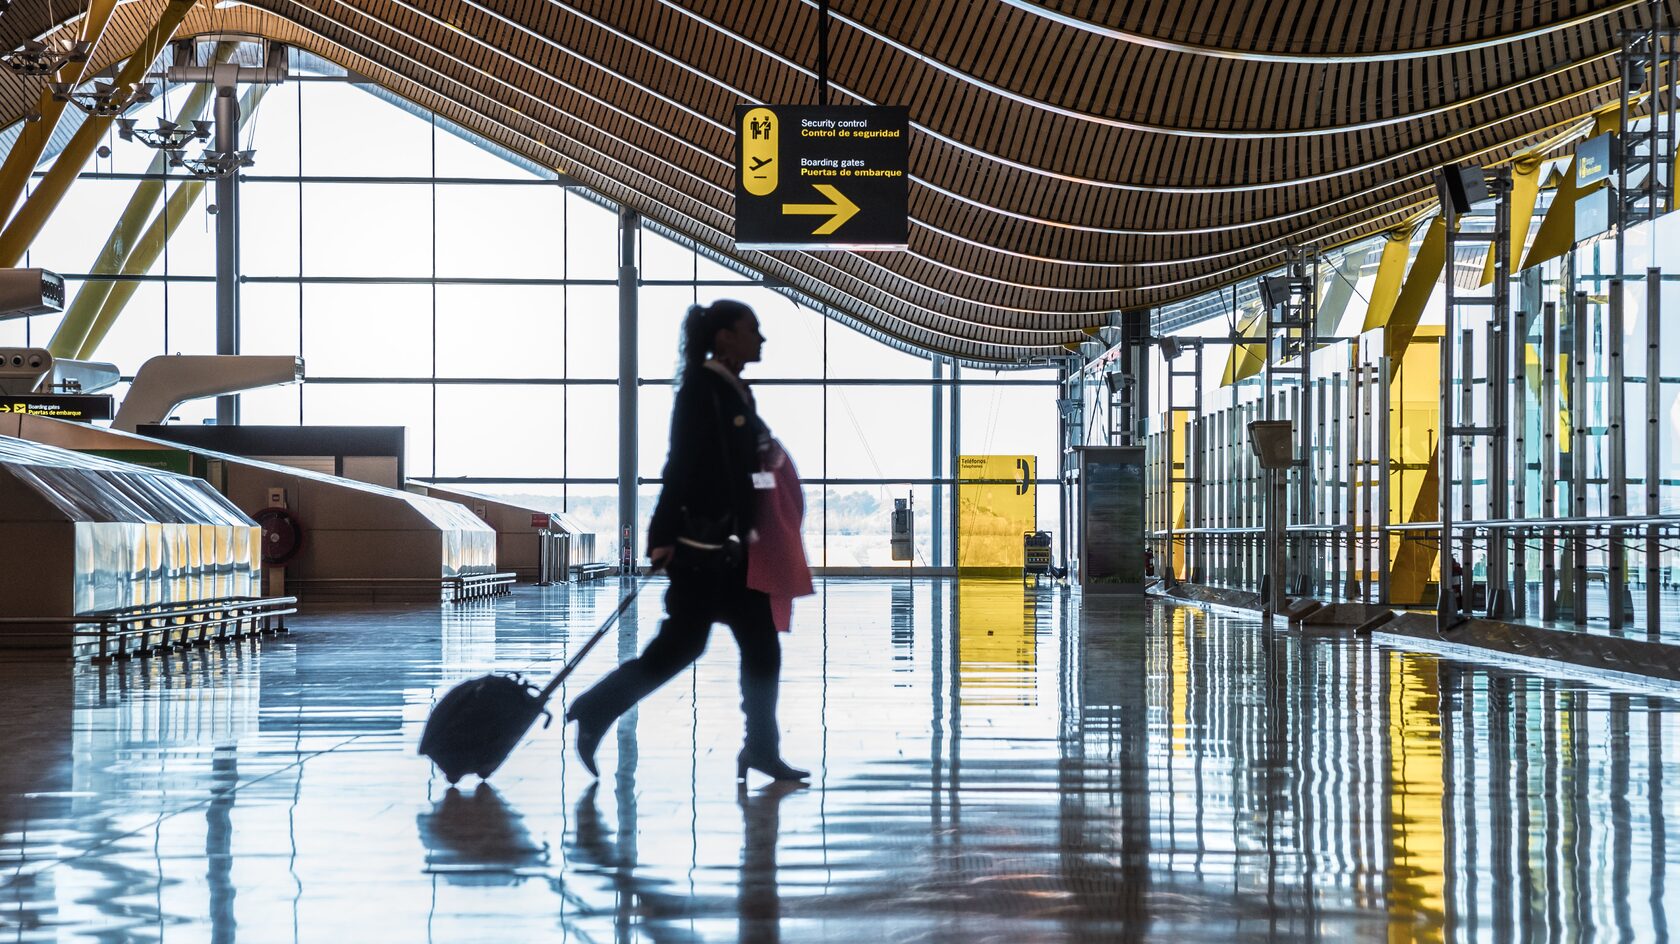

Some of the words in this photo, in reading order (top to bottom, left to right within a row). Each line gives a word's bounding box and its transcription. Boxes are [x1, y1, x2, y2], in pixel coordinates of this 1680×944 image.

[801, 119, 835, 128] Security
[801, 129, 836, 137] Control
[838, 129, 850, 137] de
[853, 129, 900, 138] seguridad
[801, 158, 839, 168] Boarding
[841, 159, 865, 168] gates
[801, 168, 837, 176] Puertas
[840, 168, 851, 176] de
[854, 168, 902, 178] embarque
